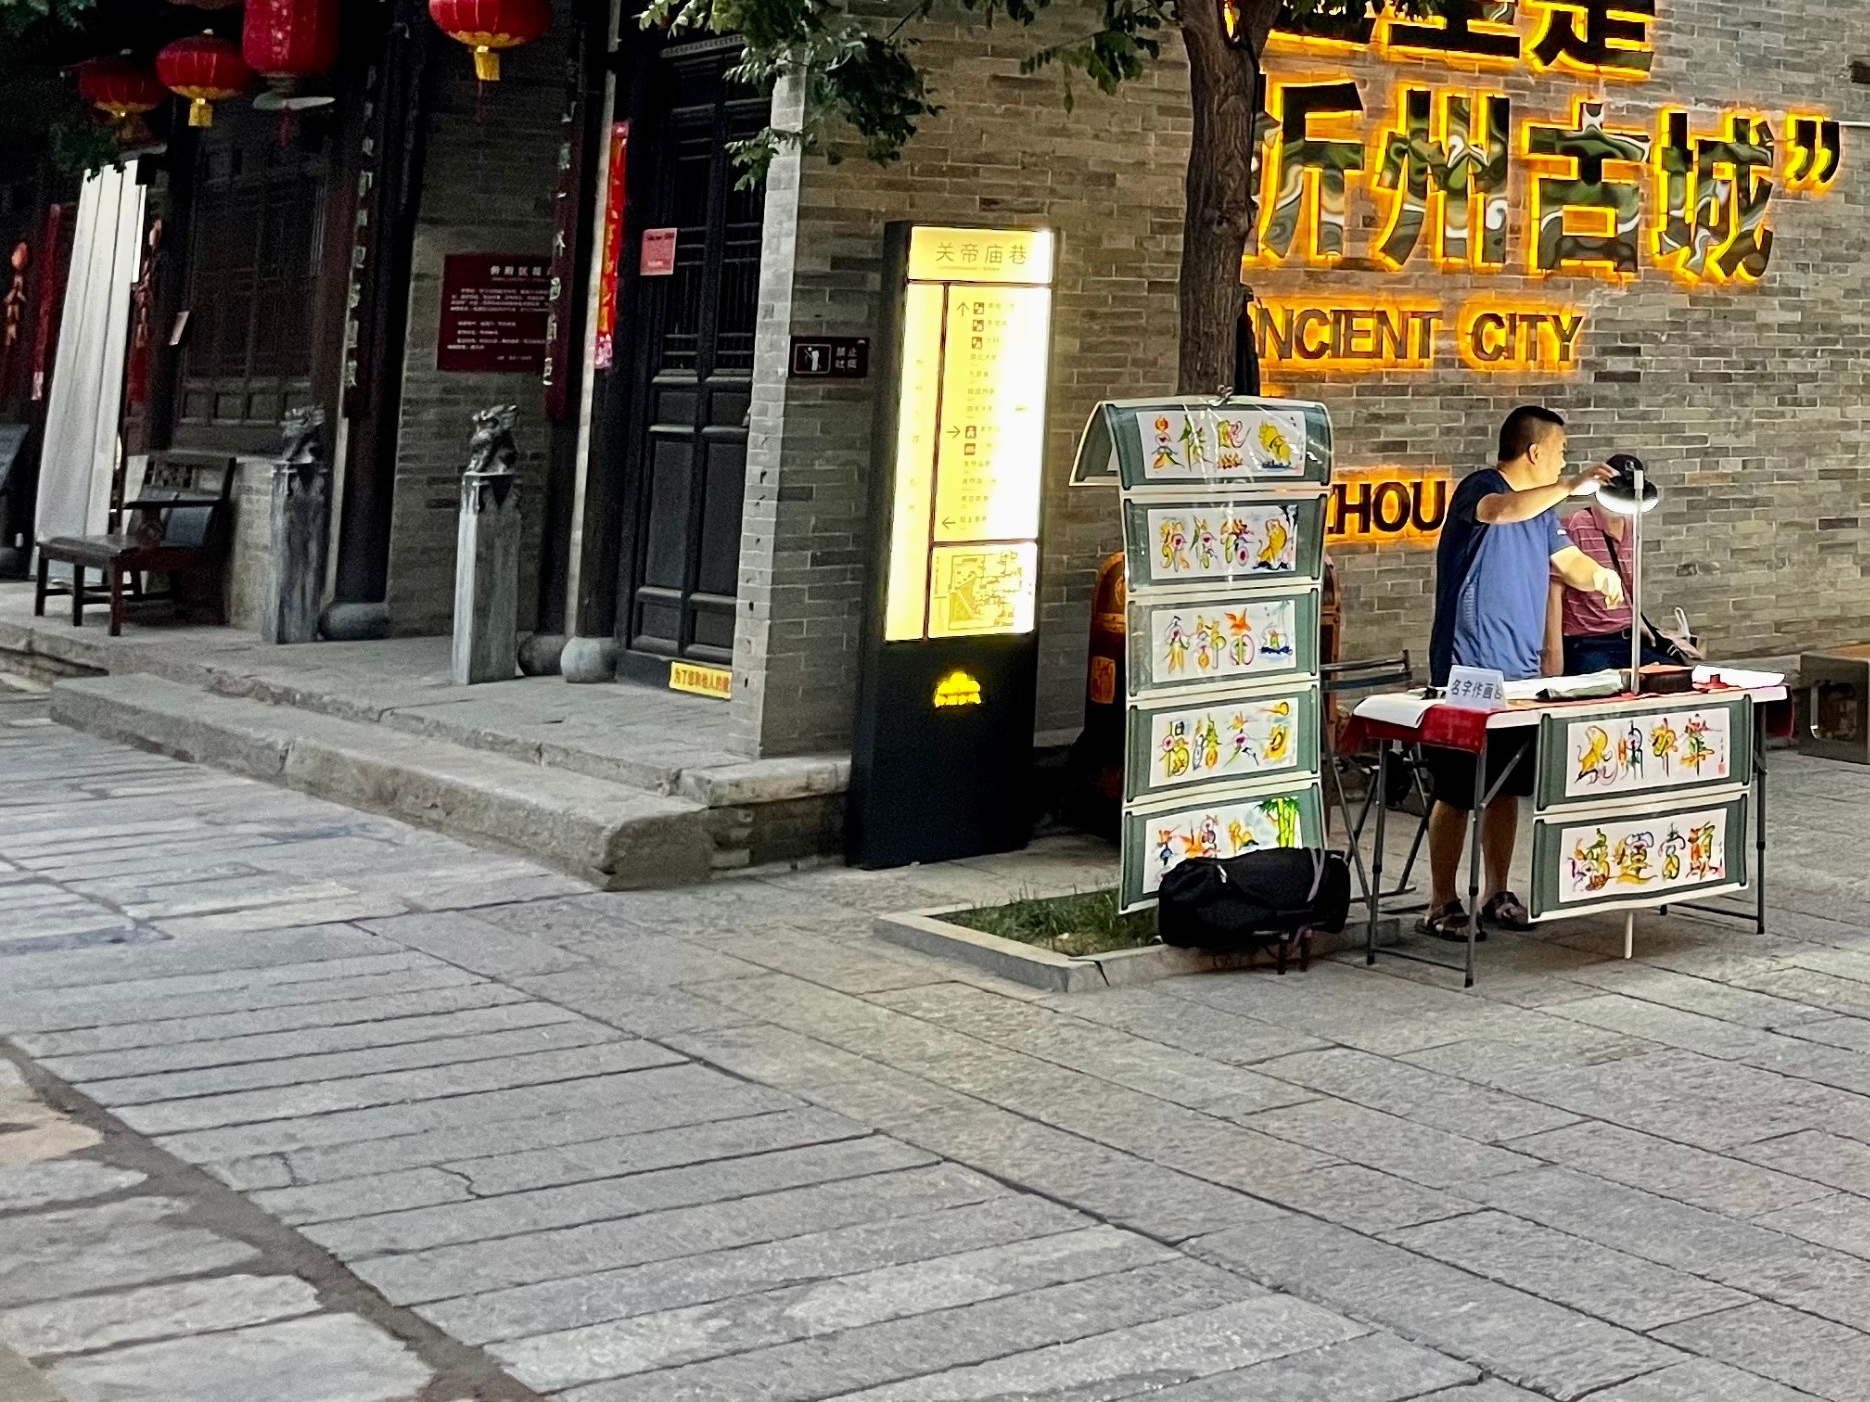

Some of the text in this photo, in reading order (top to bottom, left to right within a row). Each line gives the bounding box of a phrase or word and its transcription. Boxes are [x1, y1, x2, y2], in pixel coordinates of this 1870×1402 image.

[936, 241, 1028, 265] 关帝庙巷
[1256, 306, 1584, 363] NCIENT CITY
[1328, 480, 1447, 535] HOU
